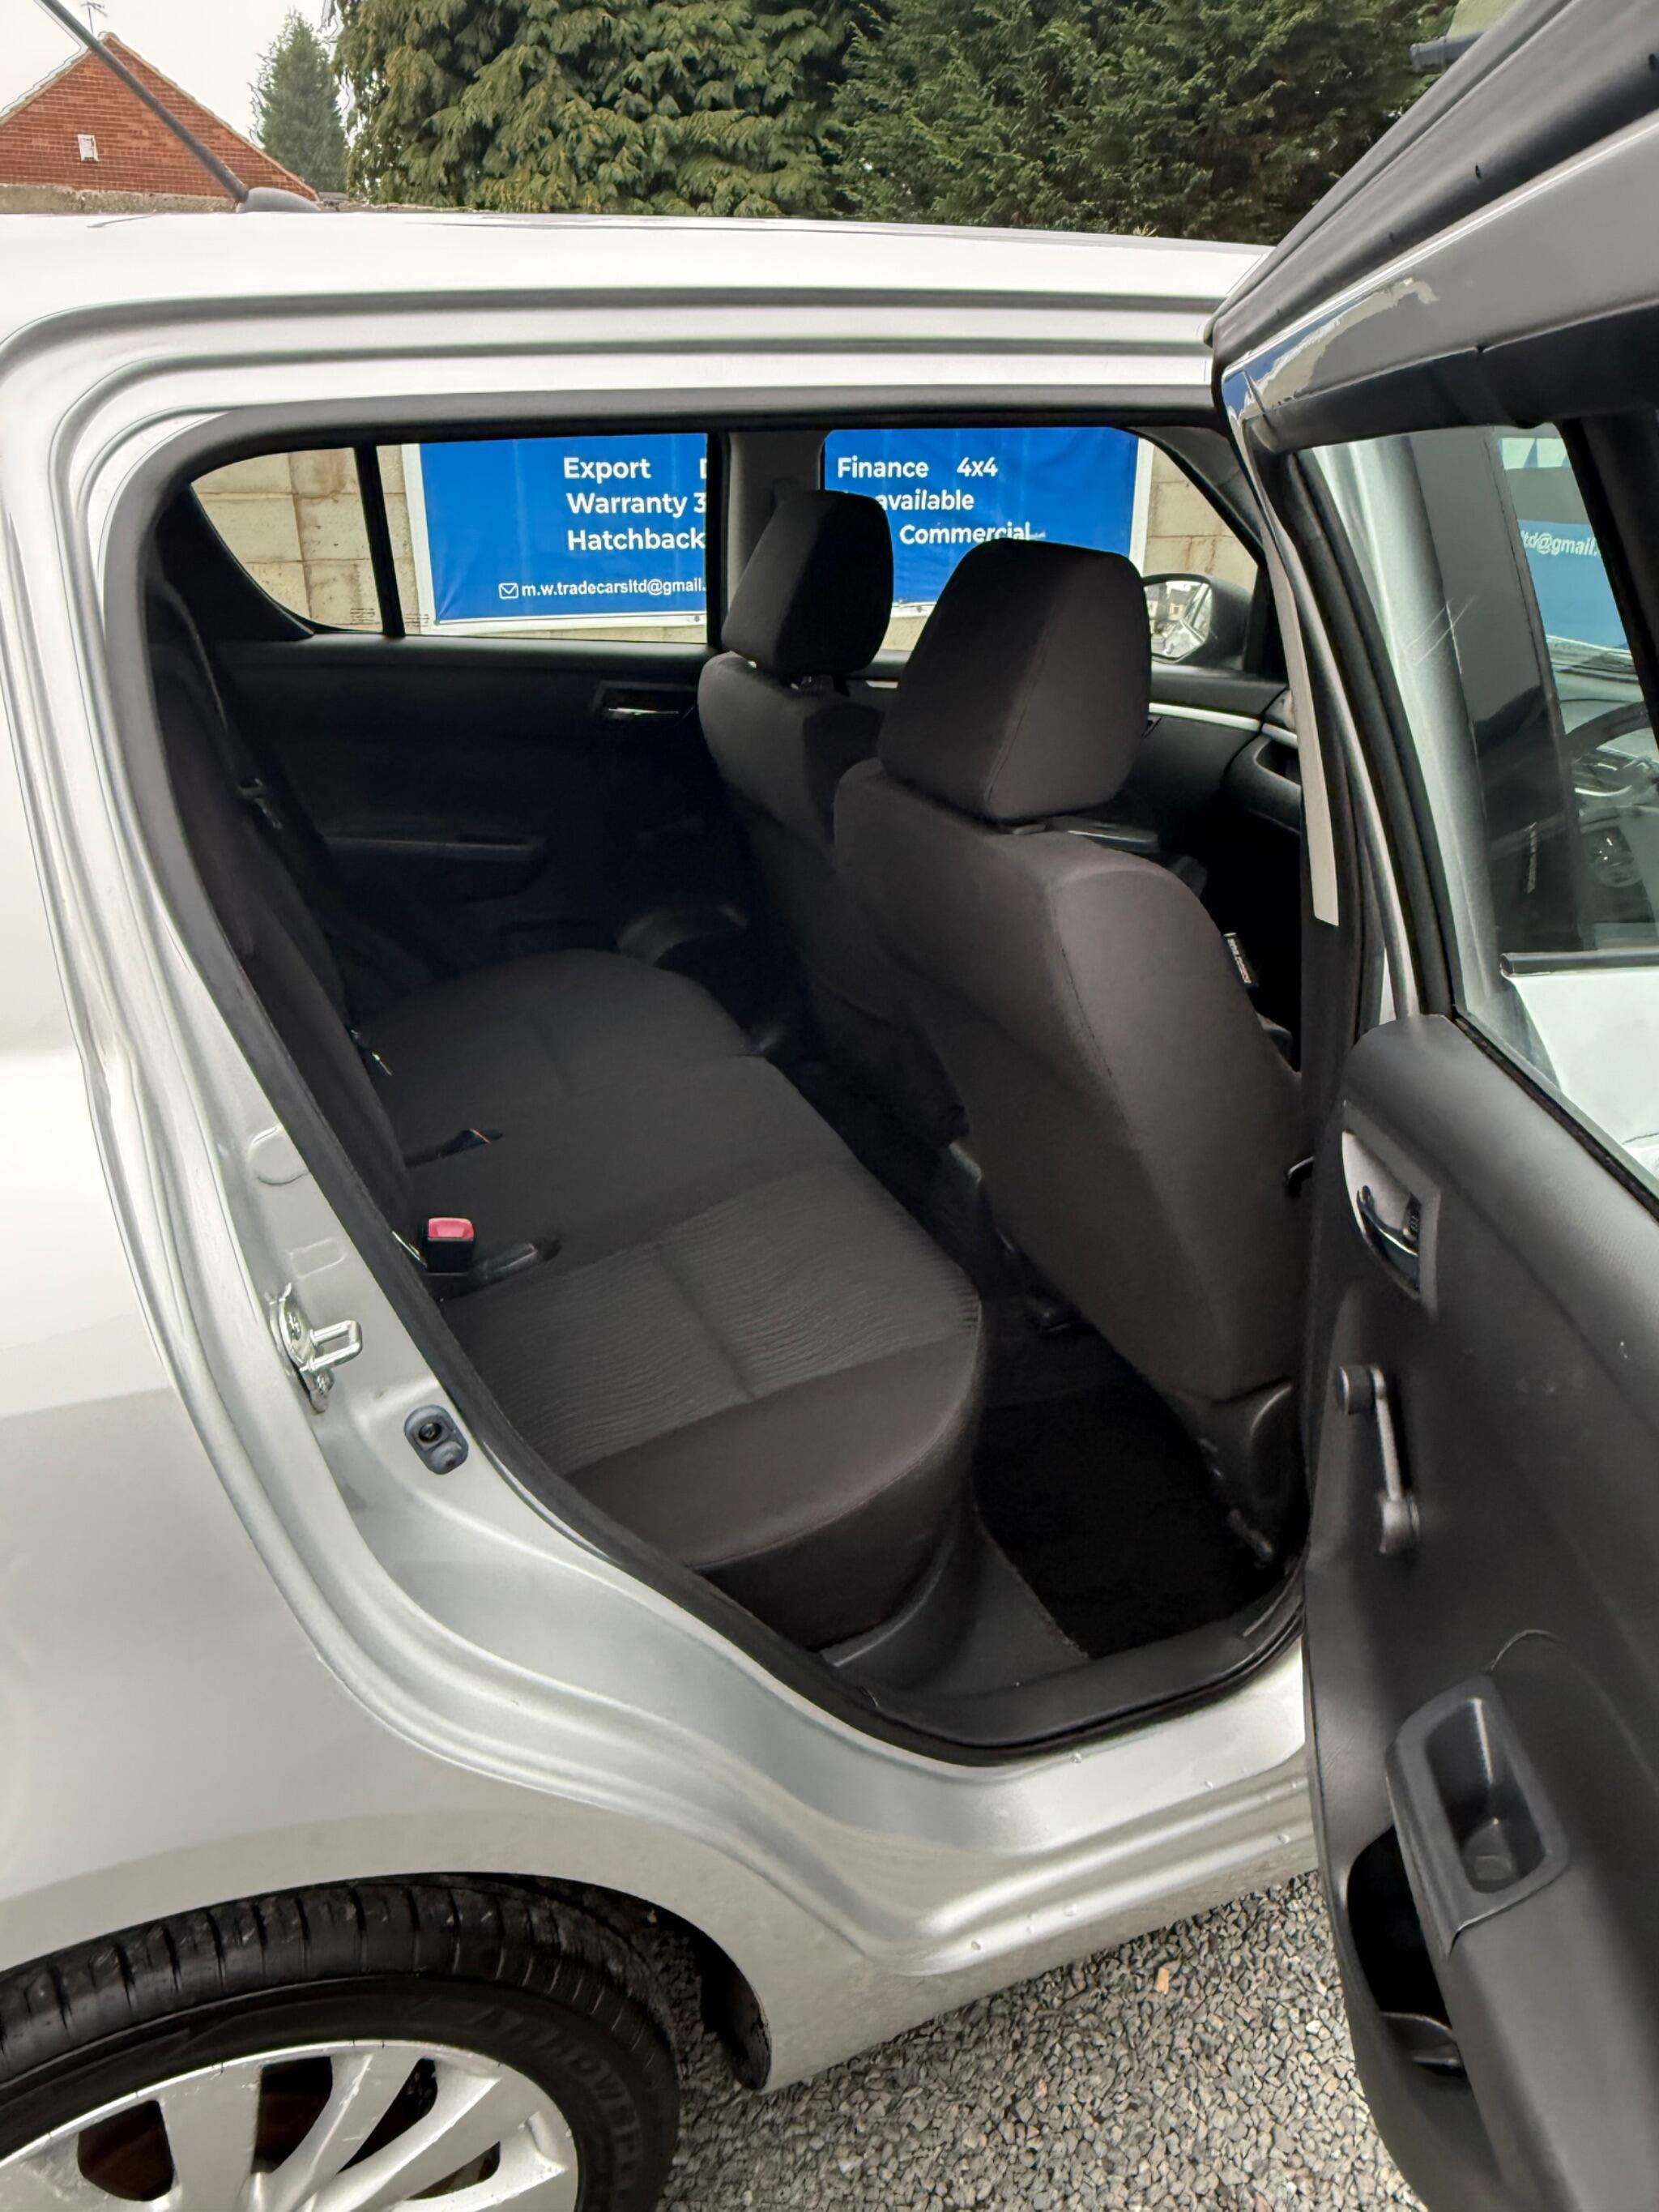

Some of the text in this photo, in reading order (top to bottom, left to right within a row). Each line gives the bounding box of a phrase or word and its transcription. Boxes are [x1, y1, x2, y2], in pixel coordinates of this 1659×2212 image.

[563, 457, 651, 484] Export
[837, 455, 998, 479] Finance 4x4
[566, 493, 687, 518] Warranty
[568, 527, 706, 551] Hatchback
